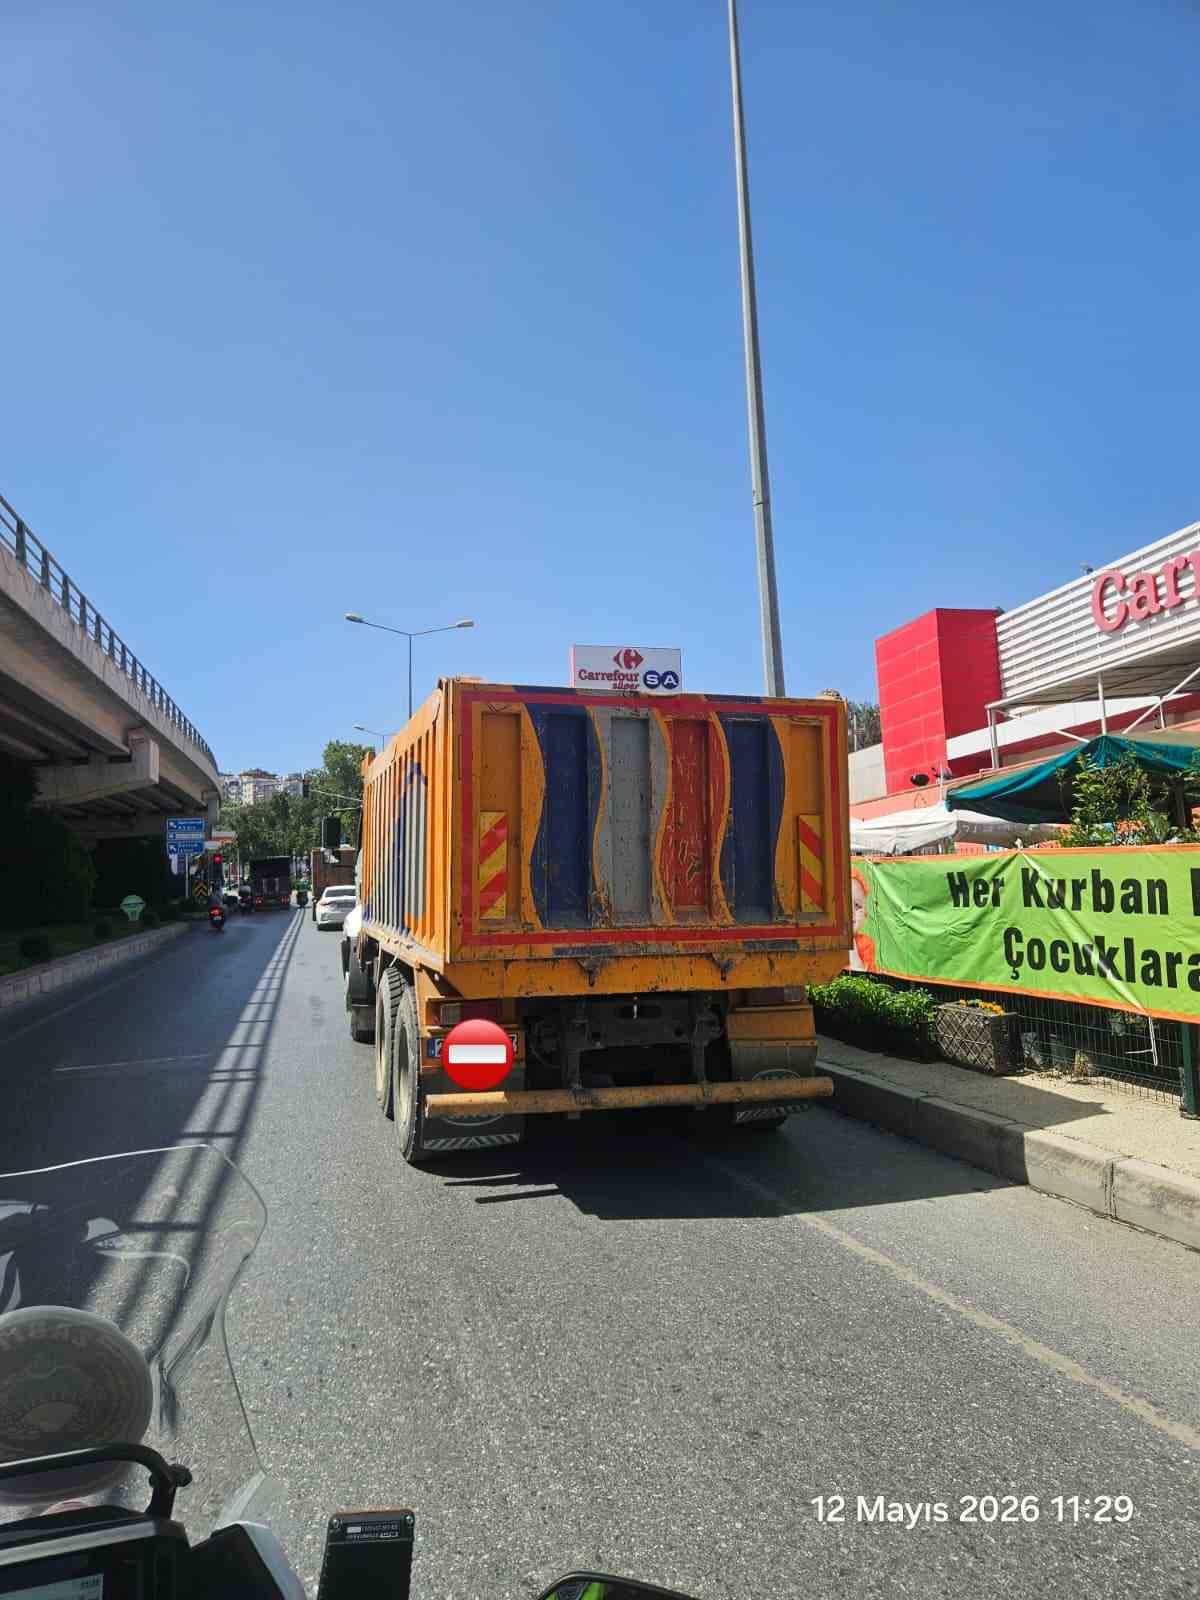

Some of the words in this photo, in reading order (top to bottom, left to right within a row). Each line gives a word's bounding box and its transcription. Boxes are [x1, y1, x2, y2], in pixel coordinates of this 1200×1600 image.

[578, 669, 640, 682] Carrefour
[645, 672, 678, 688] SA
[945, 870, 1006, 908] Her
[1020, 867, 1169, 916] Kurban
